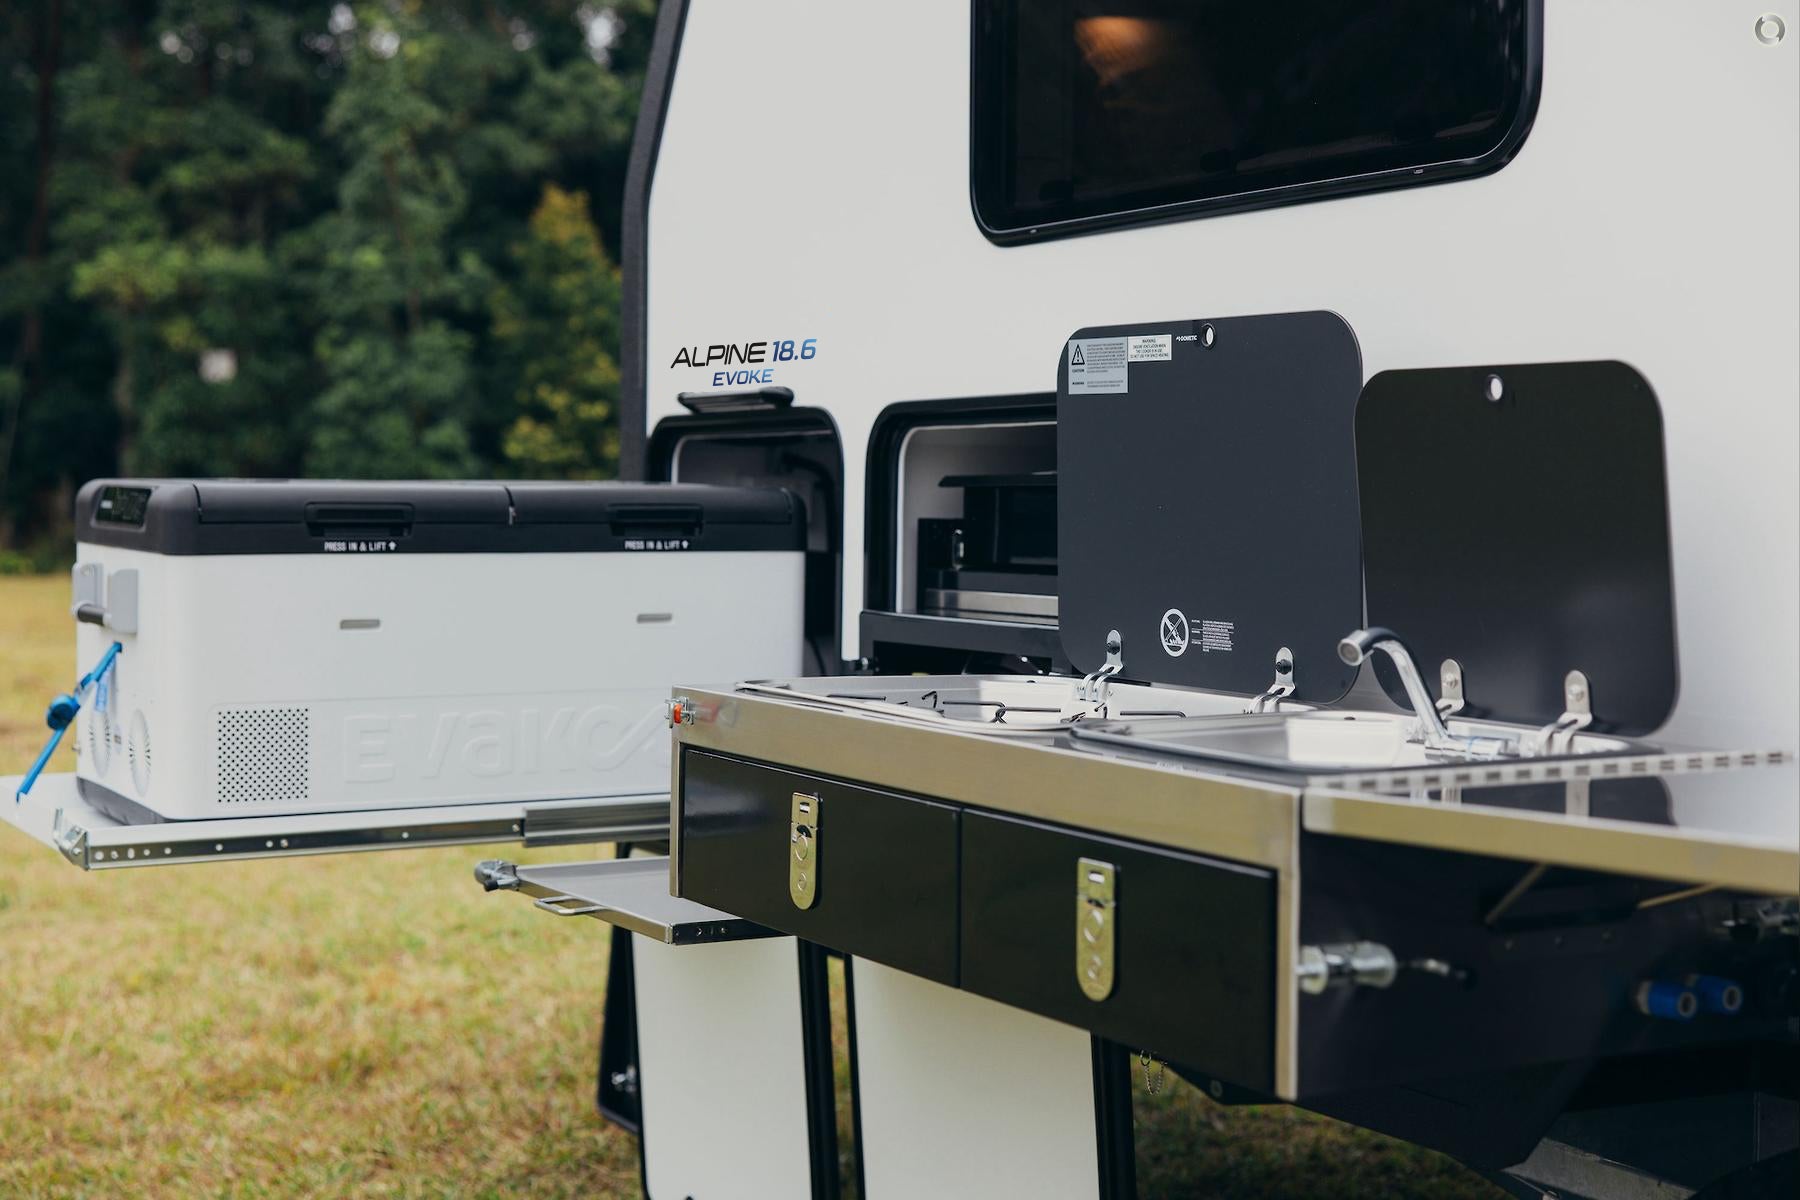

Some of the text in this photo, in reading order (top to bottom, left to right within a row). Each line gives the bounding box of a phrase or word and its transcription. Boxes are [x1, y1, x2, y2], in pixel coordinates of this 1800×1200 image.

[670, 338, 817, 369] ALPINE 18.6
[712, 368, 775, 387] EVOKE
[324, 541, 387, 552] PRESS IN & LIFT
